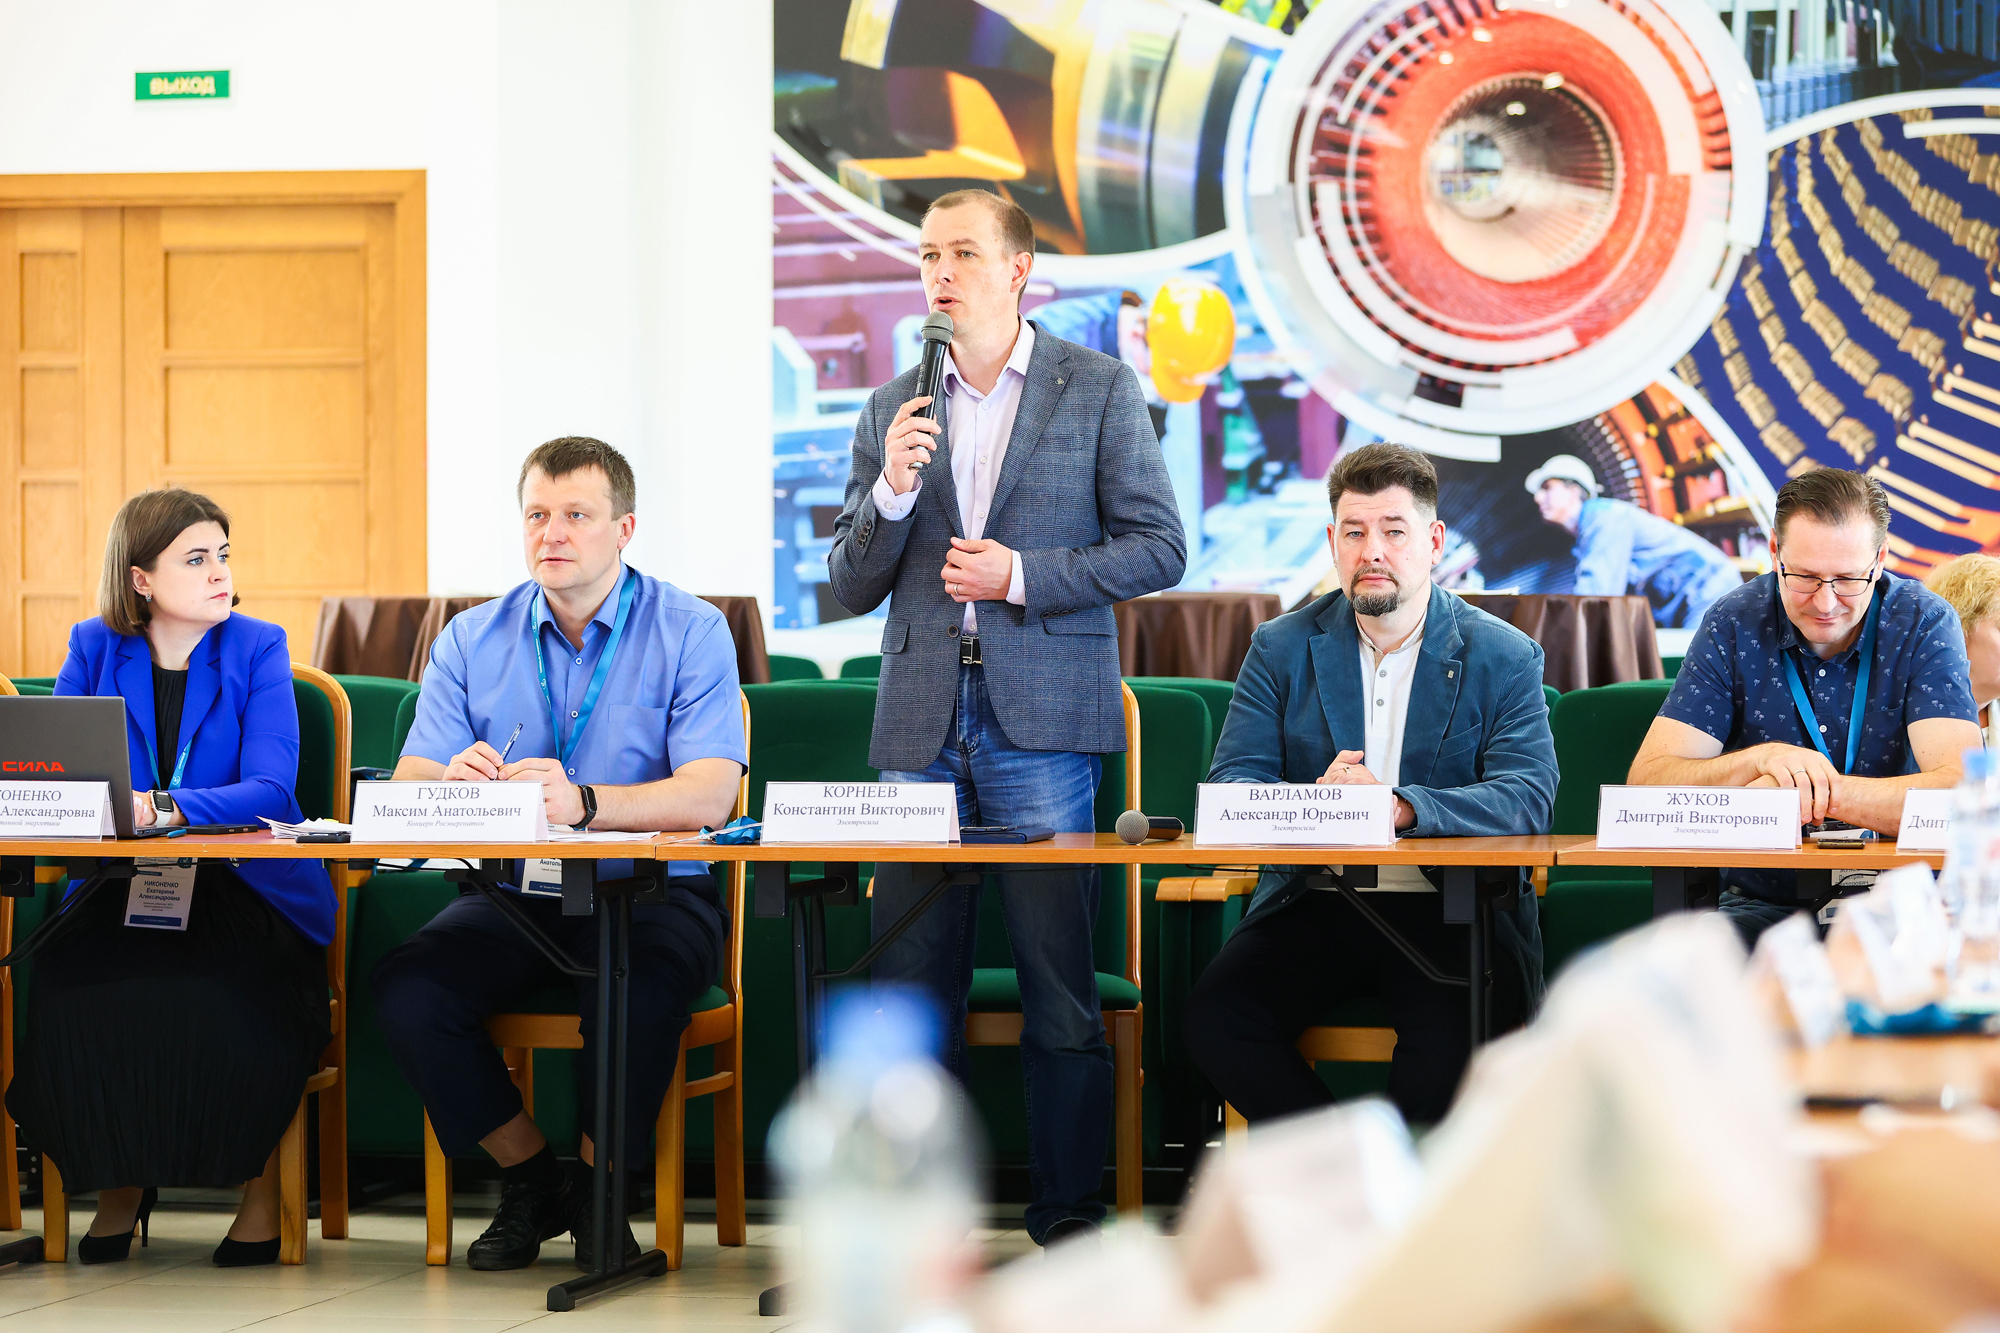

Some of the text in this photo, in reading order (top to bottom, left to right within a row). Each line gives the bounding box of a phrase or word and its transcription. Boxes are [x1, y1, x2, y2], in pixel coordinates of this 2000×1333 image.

[149, 76, 216, 96] ВЫХОД
[2, 761, 65, 772] СИЛА
[0, 789, 62, 802] ОНЕНКО
[417, 787, 480, 800] ГУДКОВ
[823, 785, 898, 798] КОРНЕЕВ
[1249, 788, 1342, 801] ВАРЛАМОВ
[1667, 793, 1730, 806] ЖУКОВ
[0, 805, 95, 820] Александровна
[372, 805, 521, 817] Максим Анатольевич
[773, 803, 945, 818] Константин Викторович
[1219, 808, 1369, 823] Александр Юрьевич
[836, 819, 879, 827] Электросила
[1615, 809, 1778, 827] Дмитрий Викторович
[1271, 825, 1316, 833] Электросила
[1673, 826, 1719, 835] Электросила
[143, 880, 179, 889] НИКОНЕНКО
